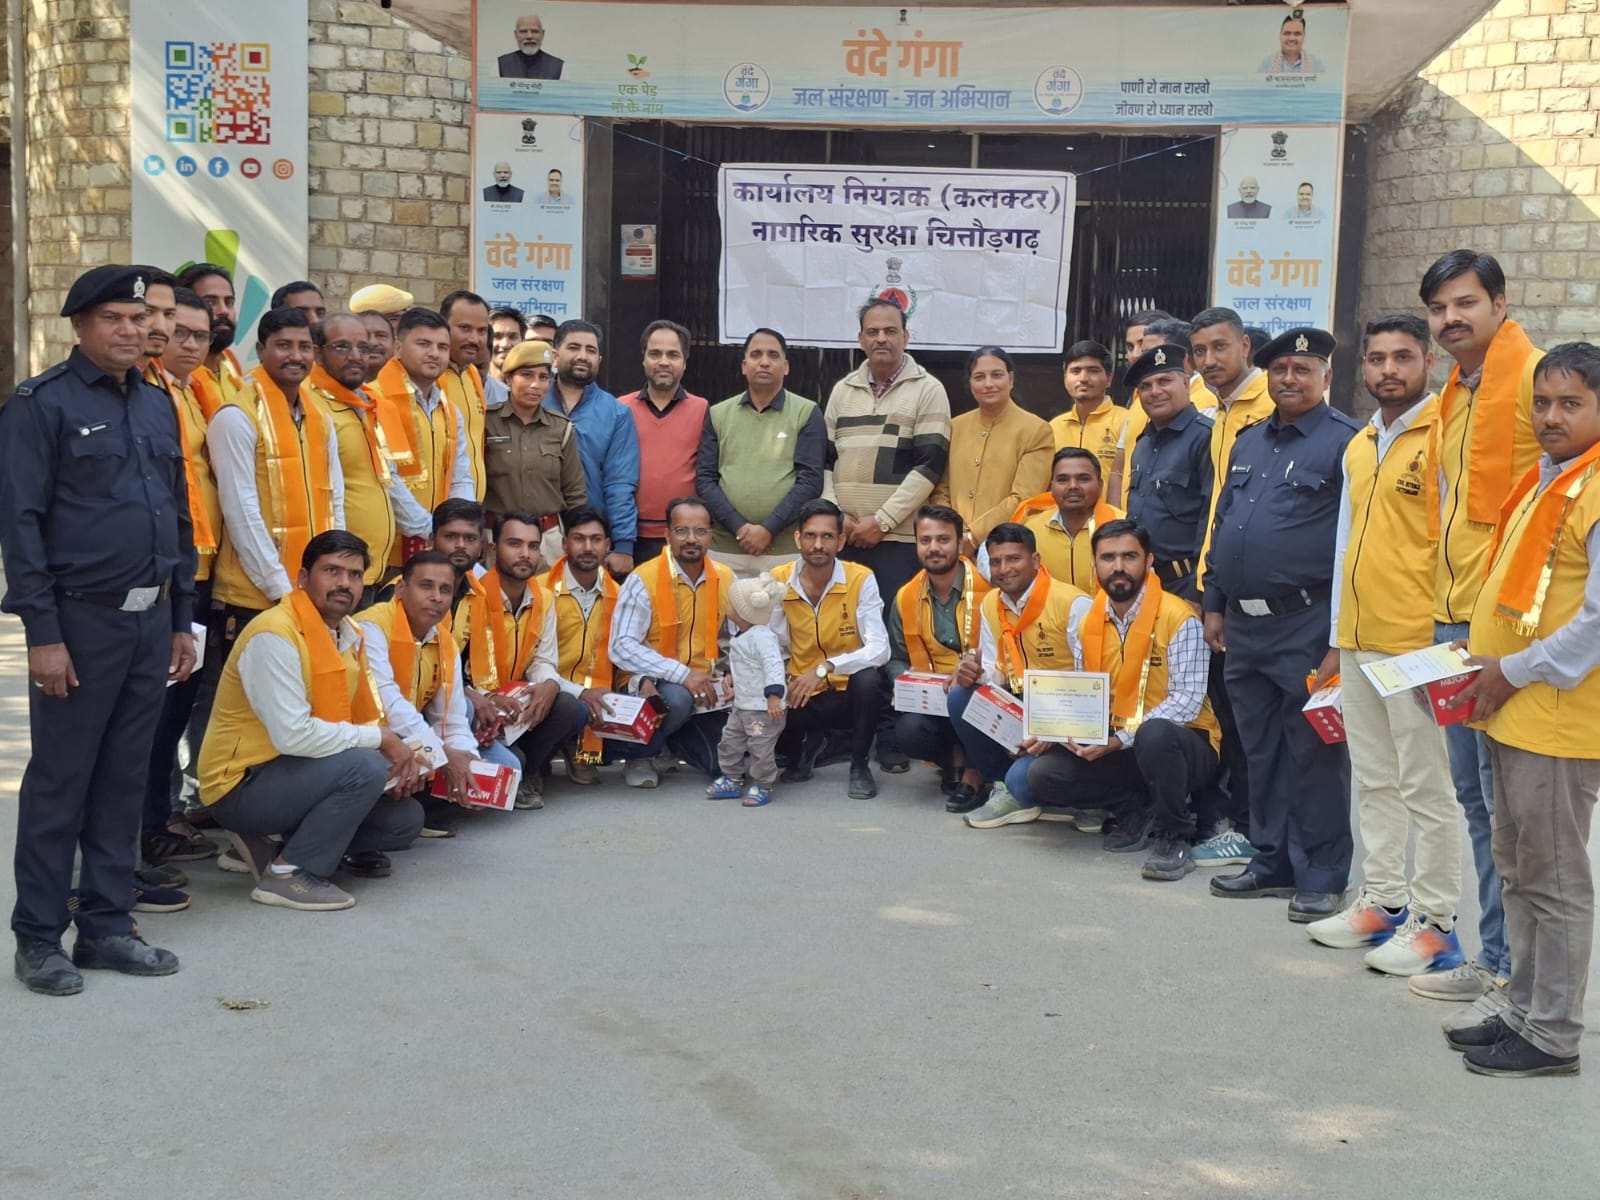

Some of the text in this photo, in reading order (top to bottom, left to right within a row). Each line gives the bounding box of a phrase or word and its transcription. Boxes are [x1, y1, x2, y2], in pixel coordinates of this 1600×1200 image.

[842, 28, 963, 77] वंदे गंगा
[618, 84, 639, 96] एक
[792, 88, 825, 107] जल
[828, 84, 889, 108] संरक्षण
[904, 89, 936, 108] जन
[940, 84, 1012, 109] अभियान
[1120, 78, 1210, 95] पाणी रो मान राखो
[1115, 100, 1213, 117] जीवण रो ध्यान राखो
[733, 174, 1062, 215] कार्यालय नियंत्रक (कलक्टर)
[752, 215, 1041, 255] नागरिक सुरक्षा चित्तौड़गढ़
[484, 233, 574, 271] वंदे गंगा
[1225, 250, 1323, 288] वंदे गंगा
[492, 275, 565, 293] जल संरक्षण
[516, 297, 569, 315] अभियान
[1232, 294, 1312, 311] जल संरक्षण
